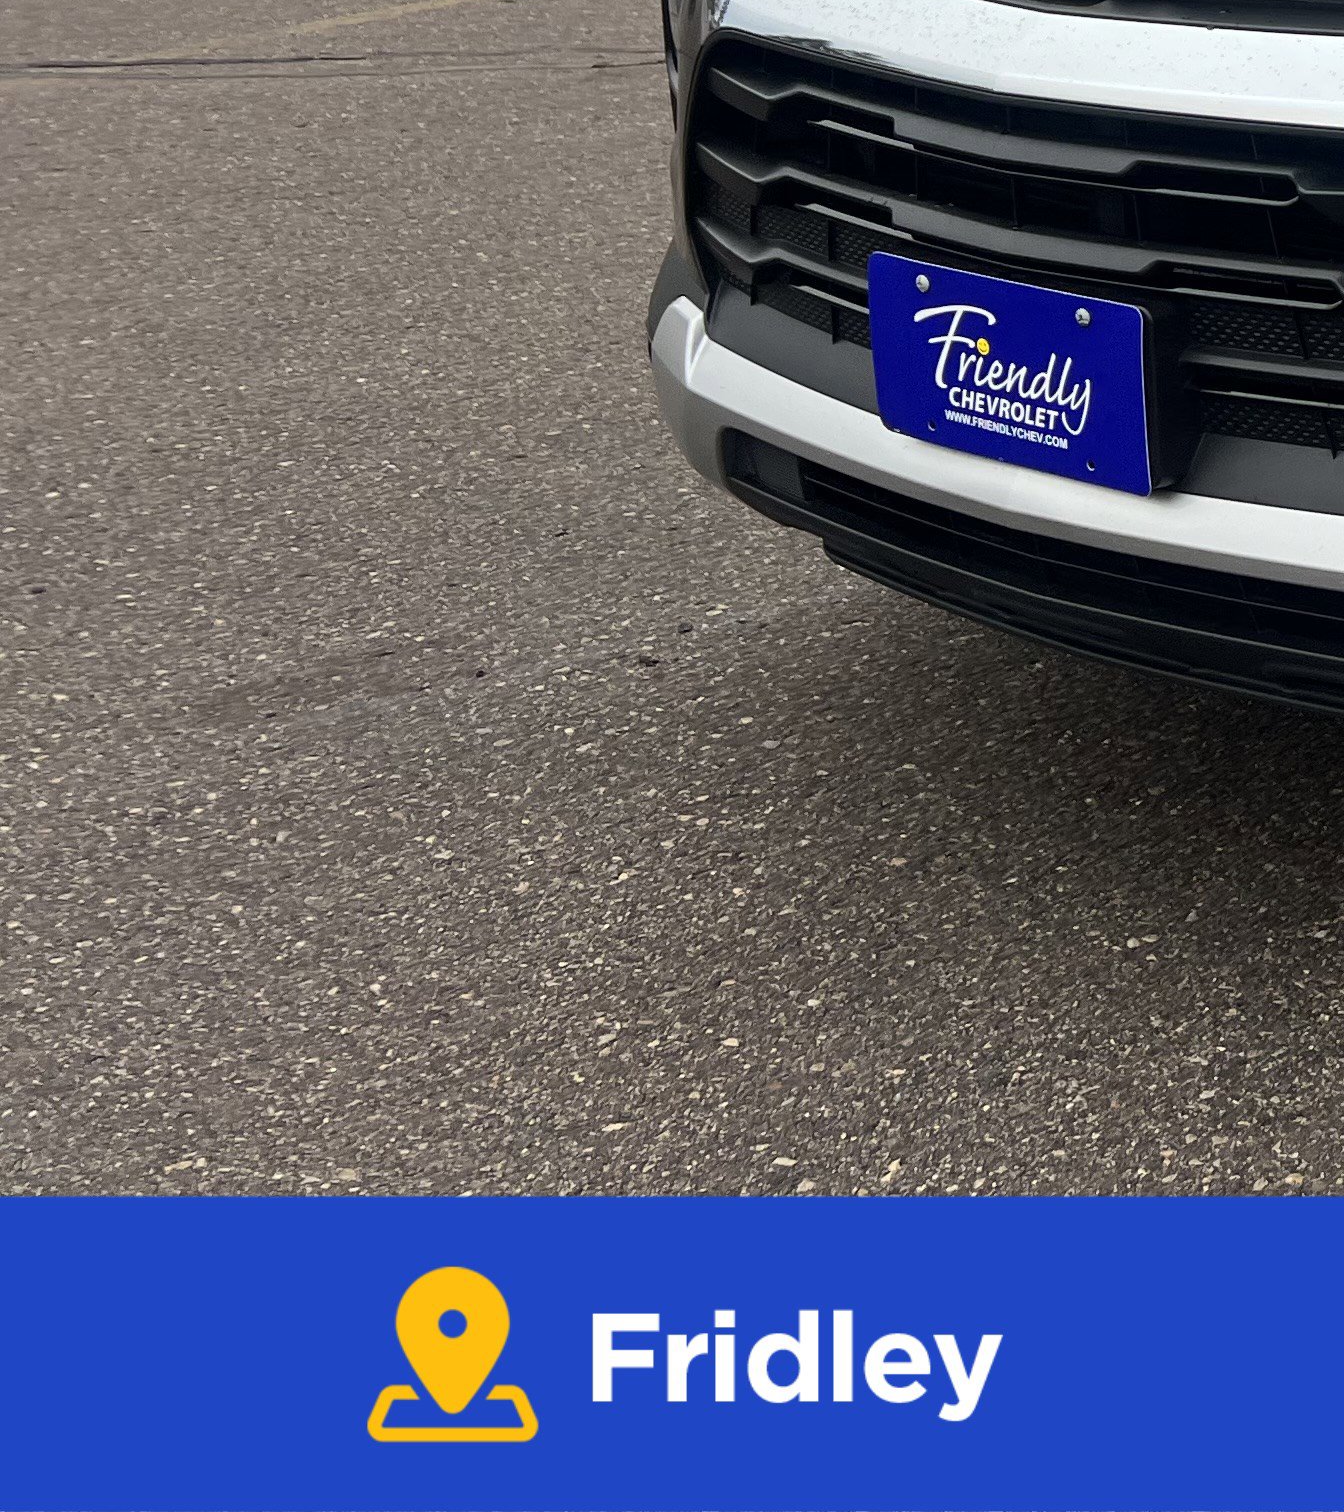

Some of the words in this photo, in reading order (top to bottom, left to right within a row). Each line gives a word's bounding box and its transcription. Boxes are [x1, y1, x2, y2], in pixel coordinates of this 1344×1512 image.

[913, 305, 1090, 435] Friendly
[944, 409, 1068, 450] WWW.FRIENDLYCHEV.COM
[948, 386, 1059, 430] CHEVROLET
